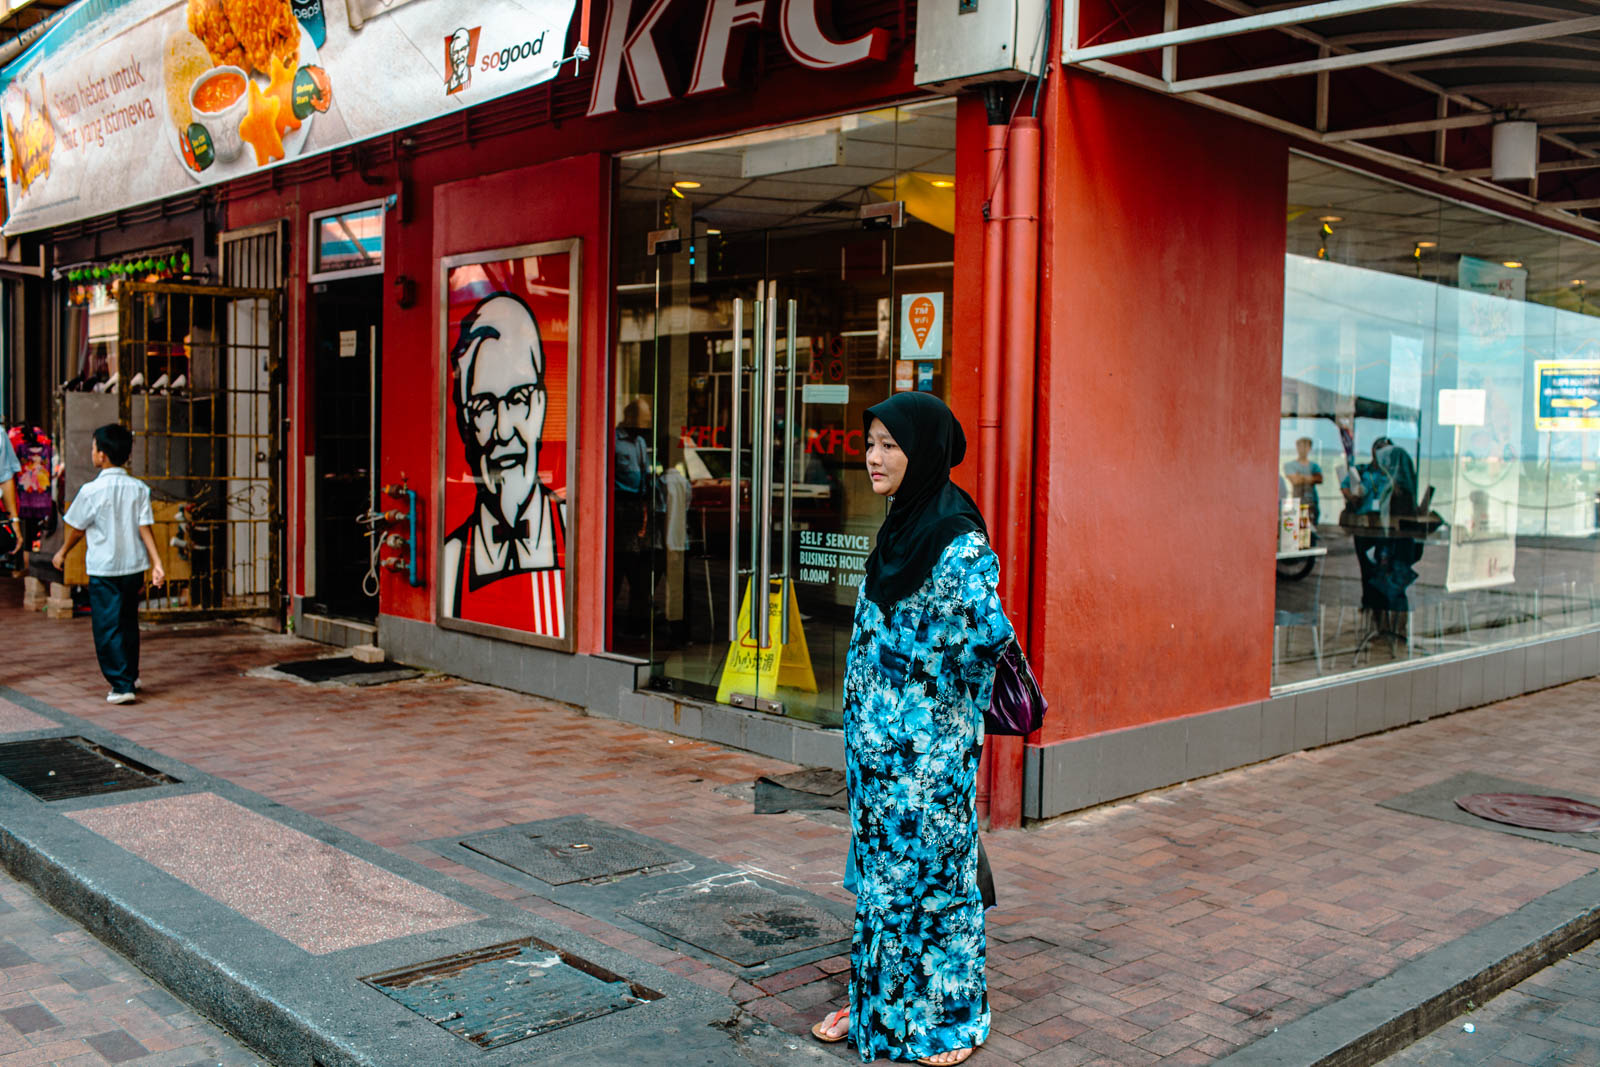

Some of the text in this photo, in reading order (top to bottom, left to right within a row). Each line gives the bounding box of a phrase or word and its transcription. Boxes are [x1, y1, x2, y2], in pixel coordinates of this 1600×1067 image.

[585, 0, 874, 116] KFC
[77, 75, 109, 110] hebat
[108, 54, 146, 95] untuk
[101, 98, 156, 135] istimewa
[677, 426, 726, 449] KFC
[804, 428, 863, 456] KFC
[800, 530, 869, 550] SELF SERVICE
[800, 550, 837, 568] BUSINESS
[800, 567, 830, 584] 10.00AM
